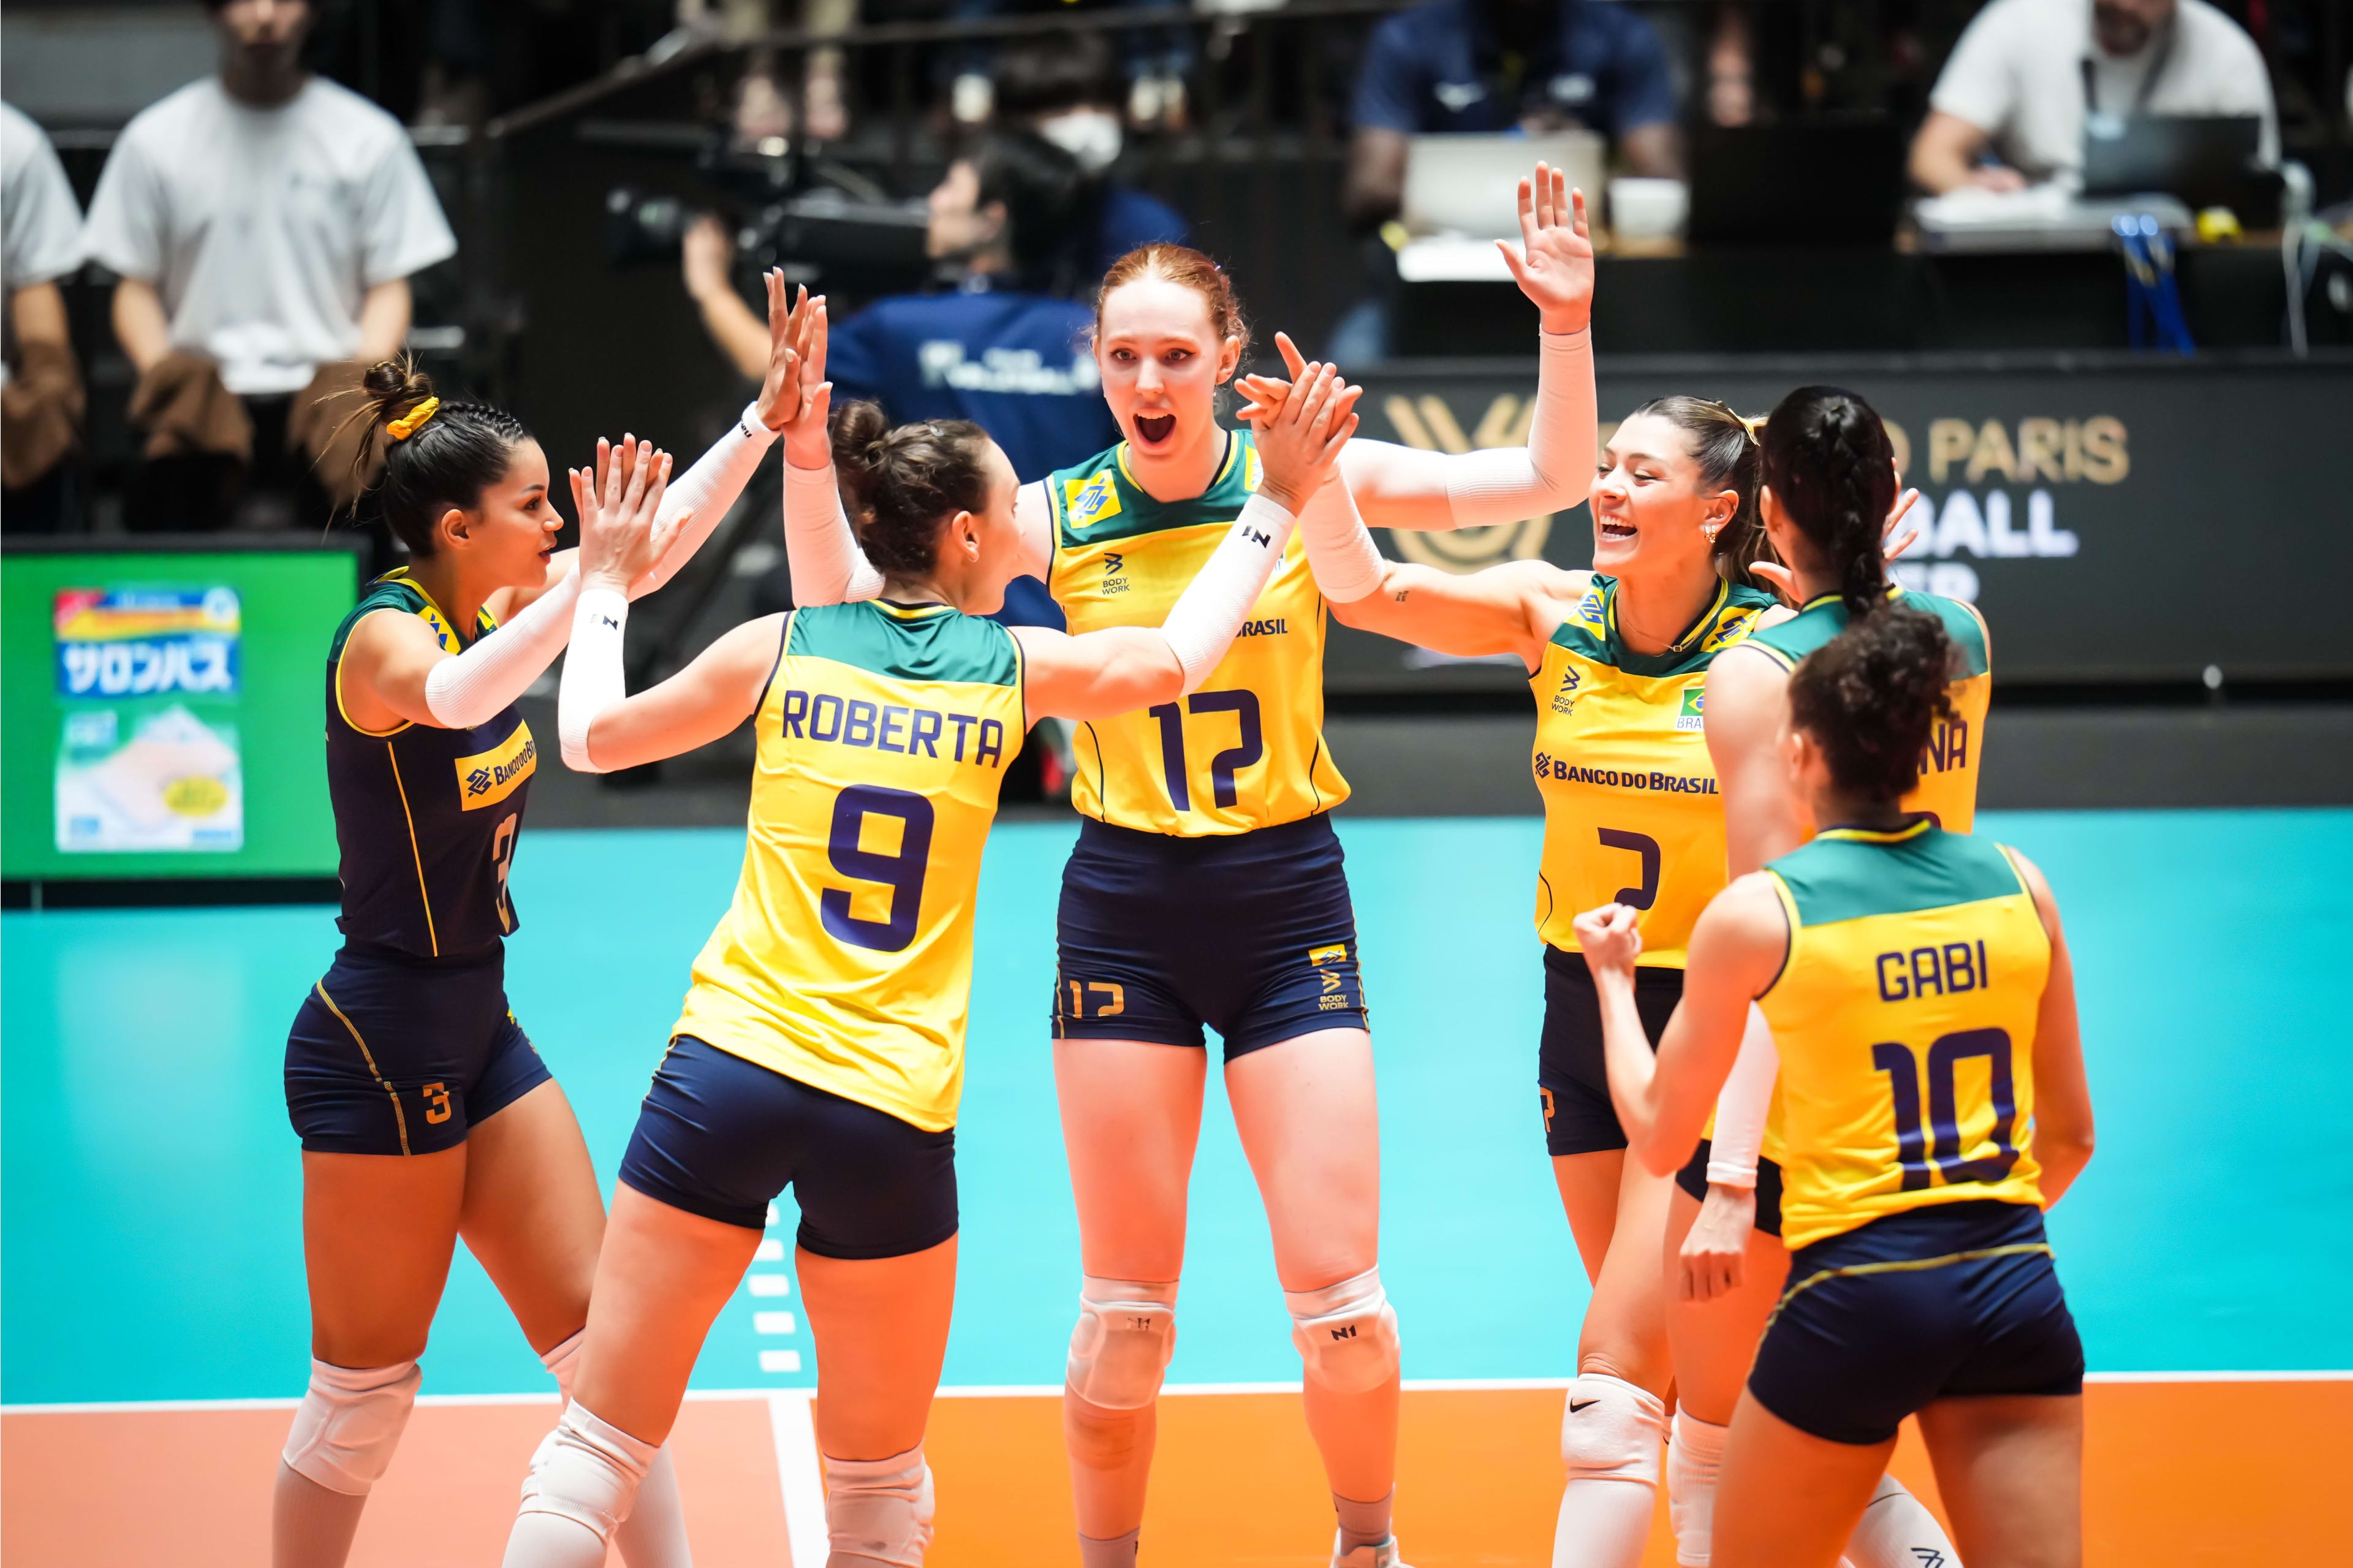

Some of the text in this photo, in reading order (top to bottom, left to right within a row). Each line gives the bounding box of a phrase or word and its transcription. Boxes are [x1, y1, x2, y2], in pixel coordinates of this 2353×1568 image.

[1929, 415, 2130, 484] PARIS
[1102, 585, 1130, 595] WORK
[1103, 577, 1128, 588] BODY
[1236, 619, 1288, 637] RASIL
[1552, 703, 1573, 716] WORK
[1555, 695, 1575, 707] BODY
[782, 690, 1004, 768] ROBERTA
[1677, 718, 1703, 729] BRA
[1554, 760, 1719, 794] BANCO DO BRASIL
[820, 784, 934, 952] 9
[1876, 939, 1988, 1002] GABI
[1320, 994, 1346, 1003] BODY
[422, 1082, 451, 1124] 3
[1871, 1026, 2020, 1192] 10
